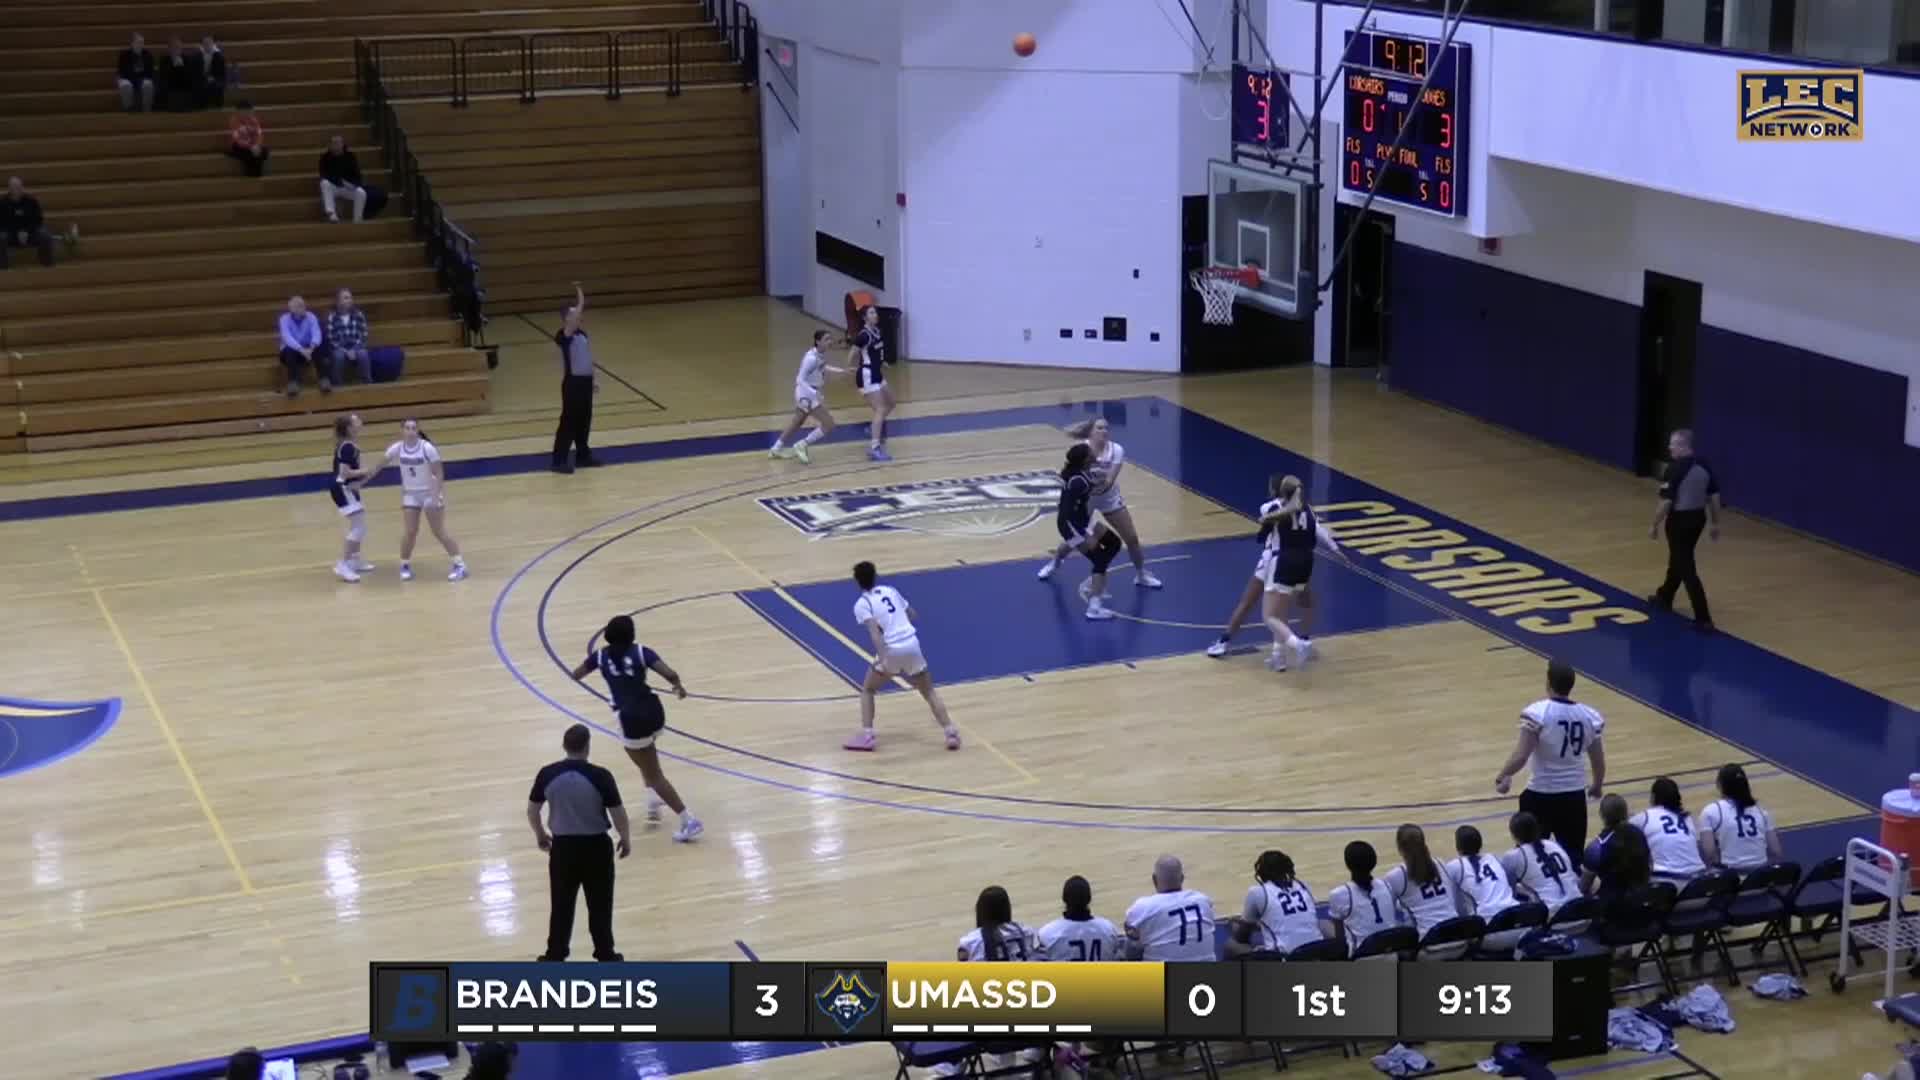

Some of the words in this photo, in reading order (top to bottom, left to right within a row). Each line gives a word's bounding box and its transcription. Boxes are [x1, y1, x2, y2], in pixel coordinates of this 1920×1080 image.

[1385, 39, 1425, 80] 9:12
[1257, 101, 1270, 140] 3
[1363, 99, 1374, 132] 0
[1440, 113, 1451, 149] 3
[1351, 160, 1360, 186] 0
[1440, 180, 1450, 208] 0
[881, 596, 897, 613] 3
[1659, 815, 1691, 836] 24
[1735, 814, 1758, 838] 13
[1277, 890, 1308, 916] 23
[1371, 897, 1384, 924] 1
[1167, 904, 1203, 946] 77
